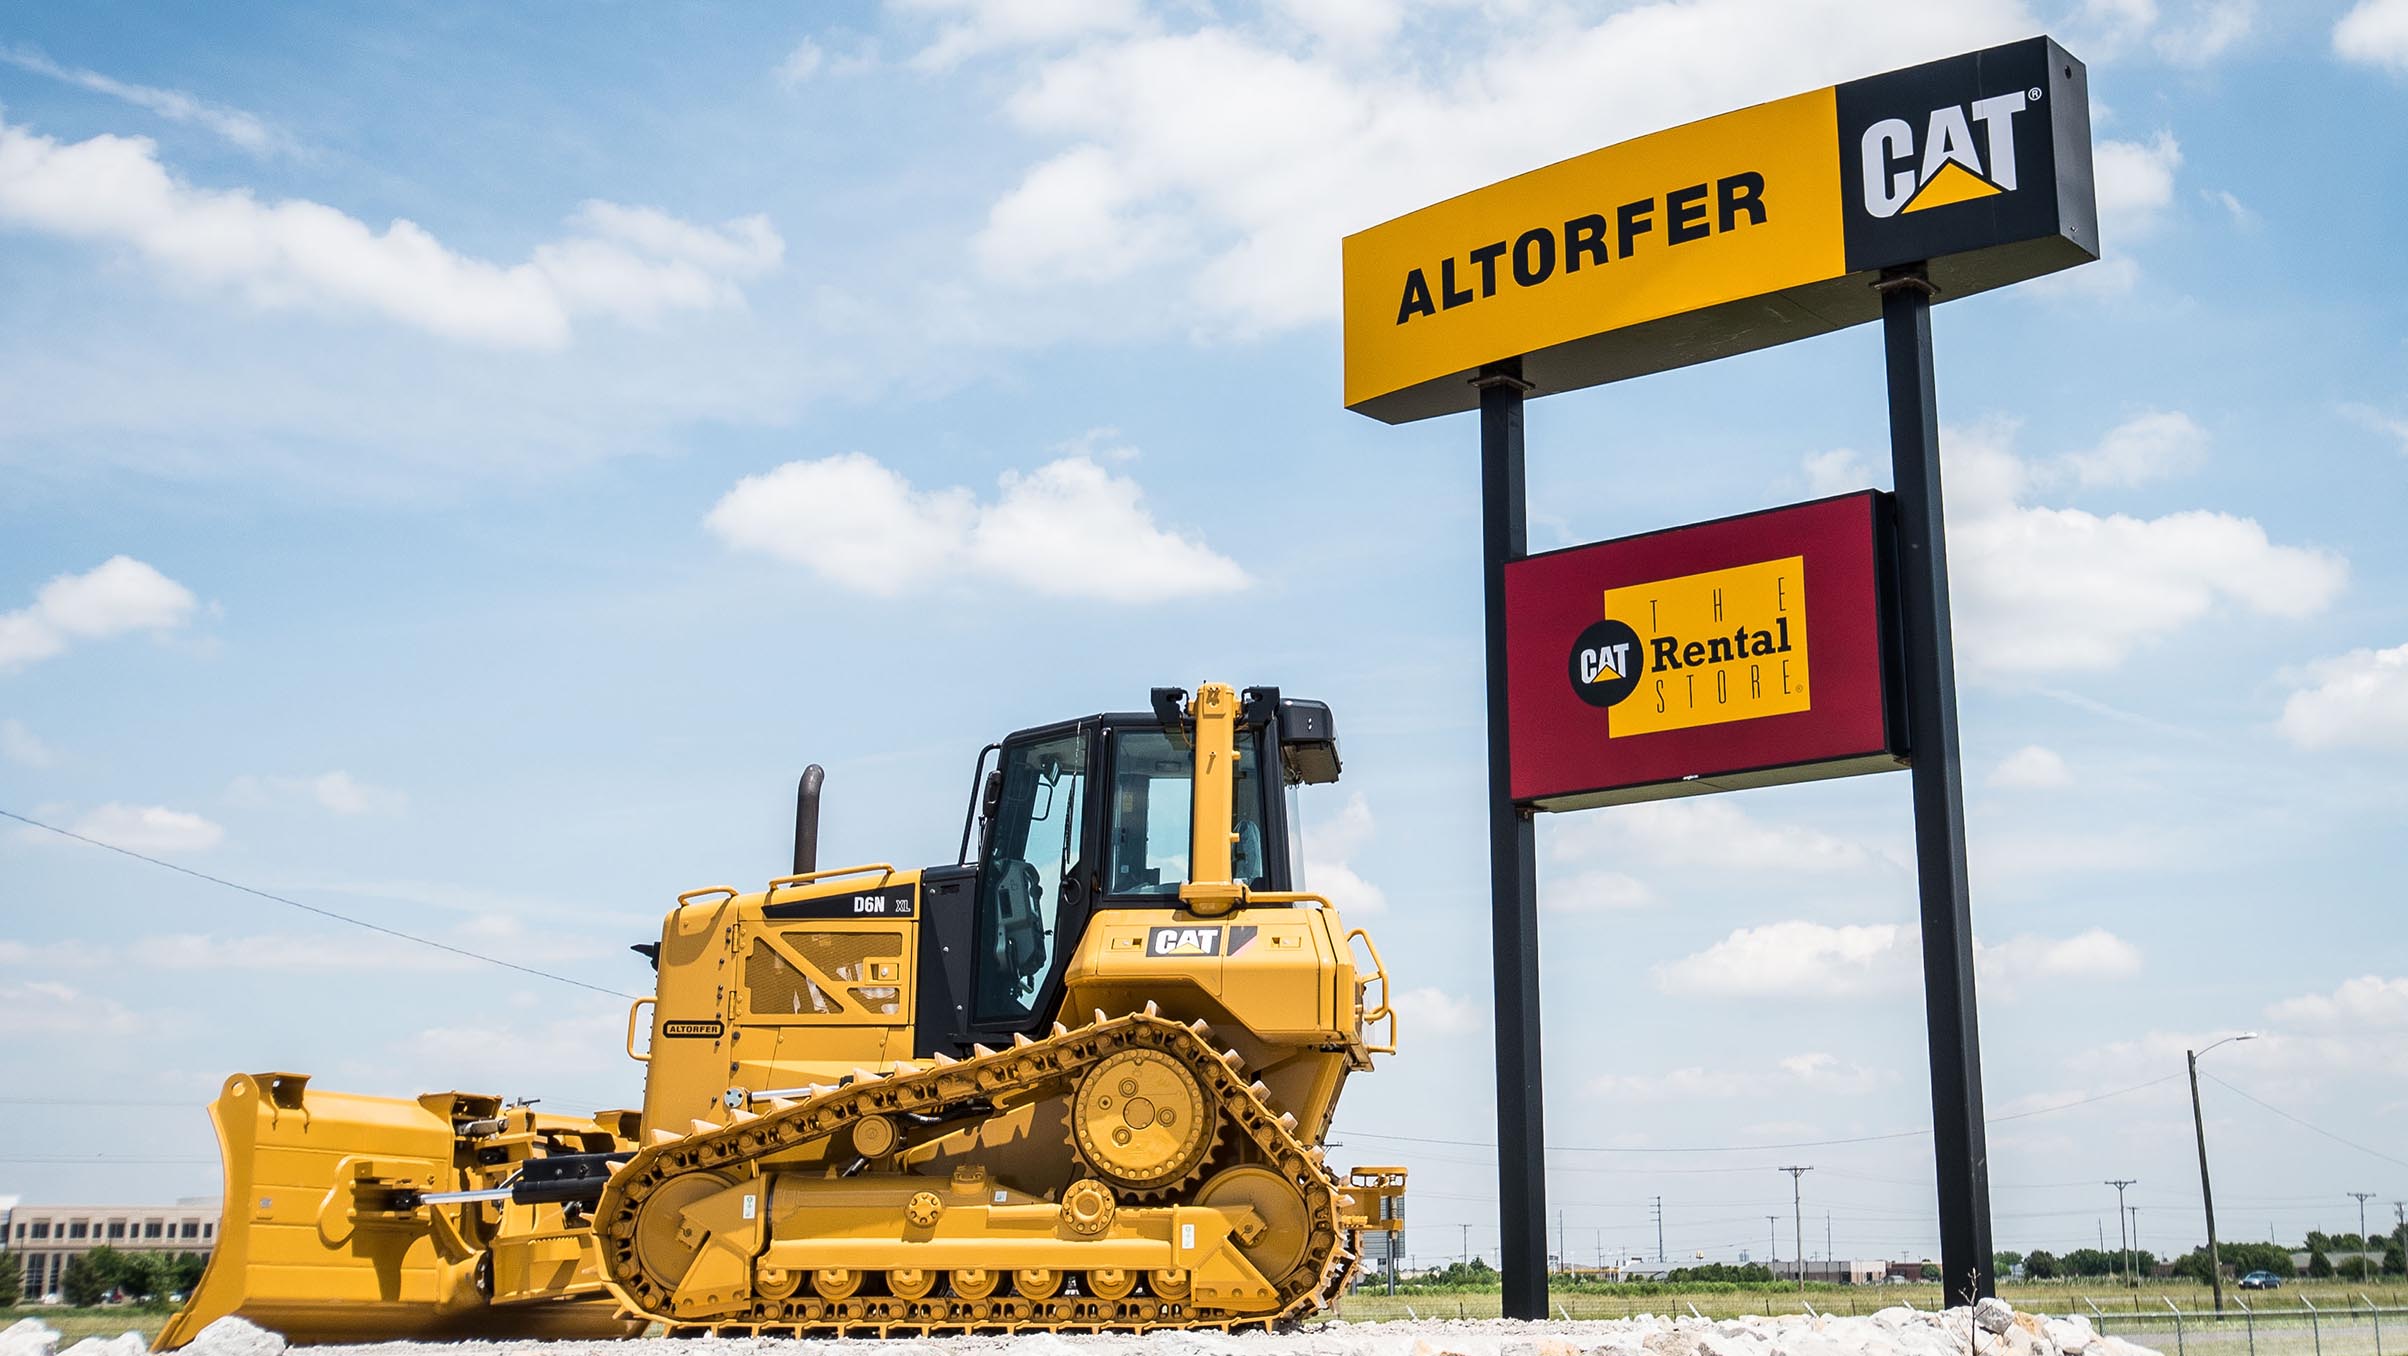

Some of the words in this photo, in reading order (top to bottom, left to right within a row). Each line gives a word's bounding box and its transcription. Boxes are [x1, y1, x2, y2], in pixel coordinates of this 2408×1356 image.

[1396, 170, 1768, 326] ALTORFER
[1861, 90, 2026, 218] CAT
[1650, 577, 1786, 632] THE
[1580, 642, 1629, 684] CAT
[1650, 616, 1792, 673] Rental
[1656, 660, 1791, 713] STORE
[853, 895, 886, 913] D6N
[894, 899, 911, 913] XL
[1155, 929, 1218, 955] CAT
[669, 1025, 718, 1033] ALTORFER
